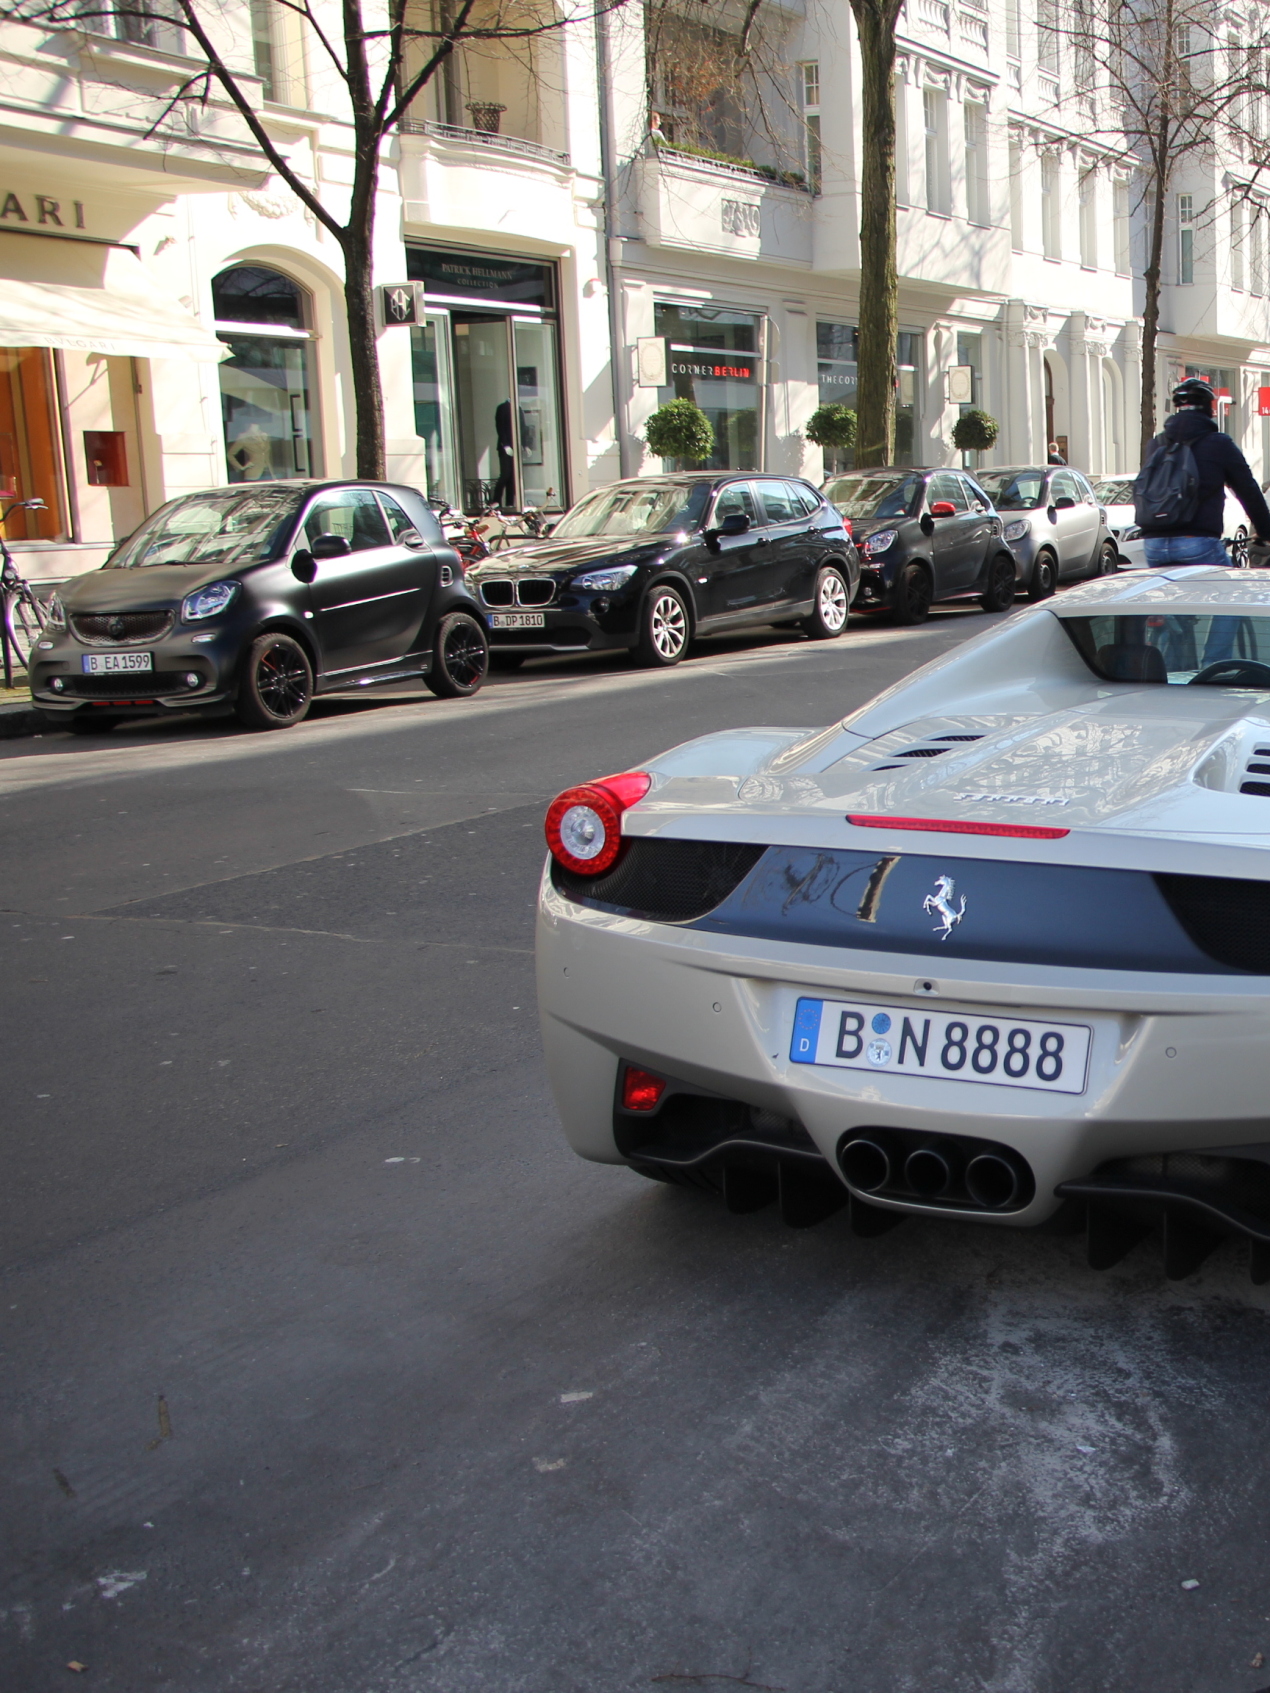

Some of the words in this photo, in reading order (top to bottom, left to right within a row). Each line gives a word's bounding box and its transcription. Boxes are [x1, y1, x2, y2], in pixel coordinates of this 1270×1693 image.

[441, 263, 471, 275] PATRICK
[472, 267, 513, 280] HELLMANN
[457, 279, 499, 289] COLLECTION
[493, 615, 500, 627] B
[505, 615, 518, 626] DP
[519, 615, 543, 626] 1810
[90, 656, 98, 671] B
[104, 656, 120, 670] EA
[121, 654, 150, 669] 1599
[800, 1038, 810, 1052] D
[835, 1010, 865, 1060] B
[897, 1016, 931, 1067] N
[940, 1021, 1065, 1082] 8888
